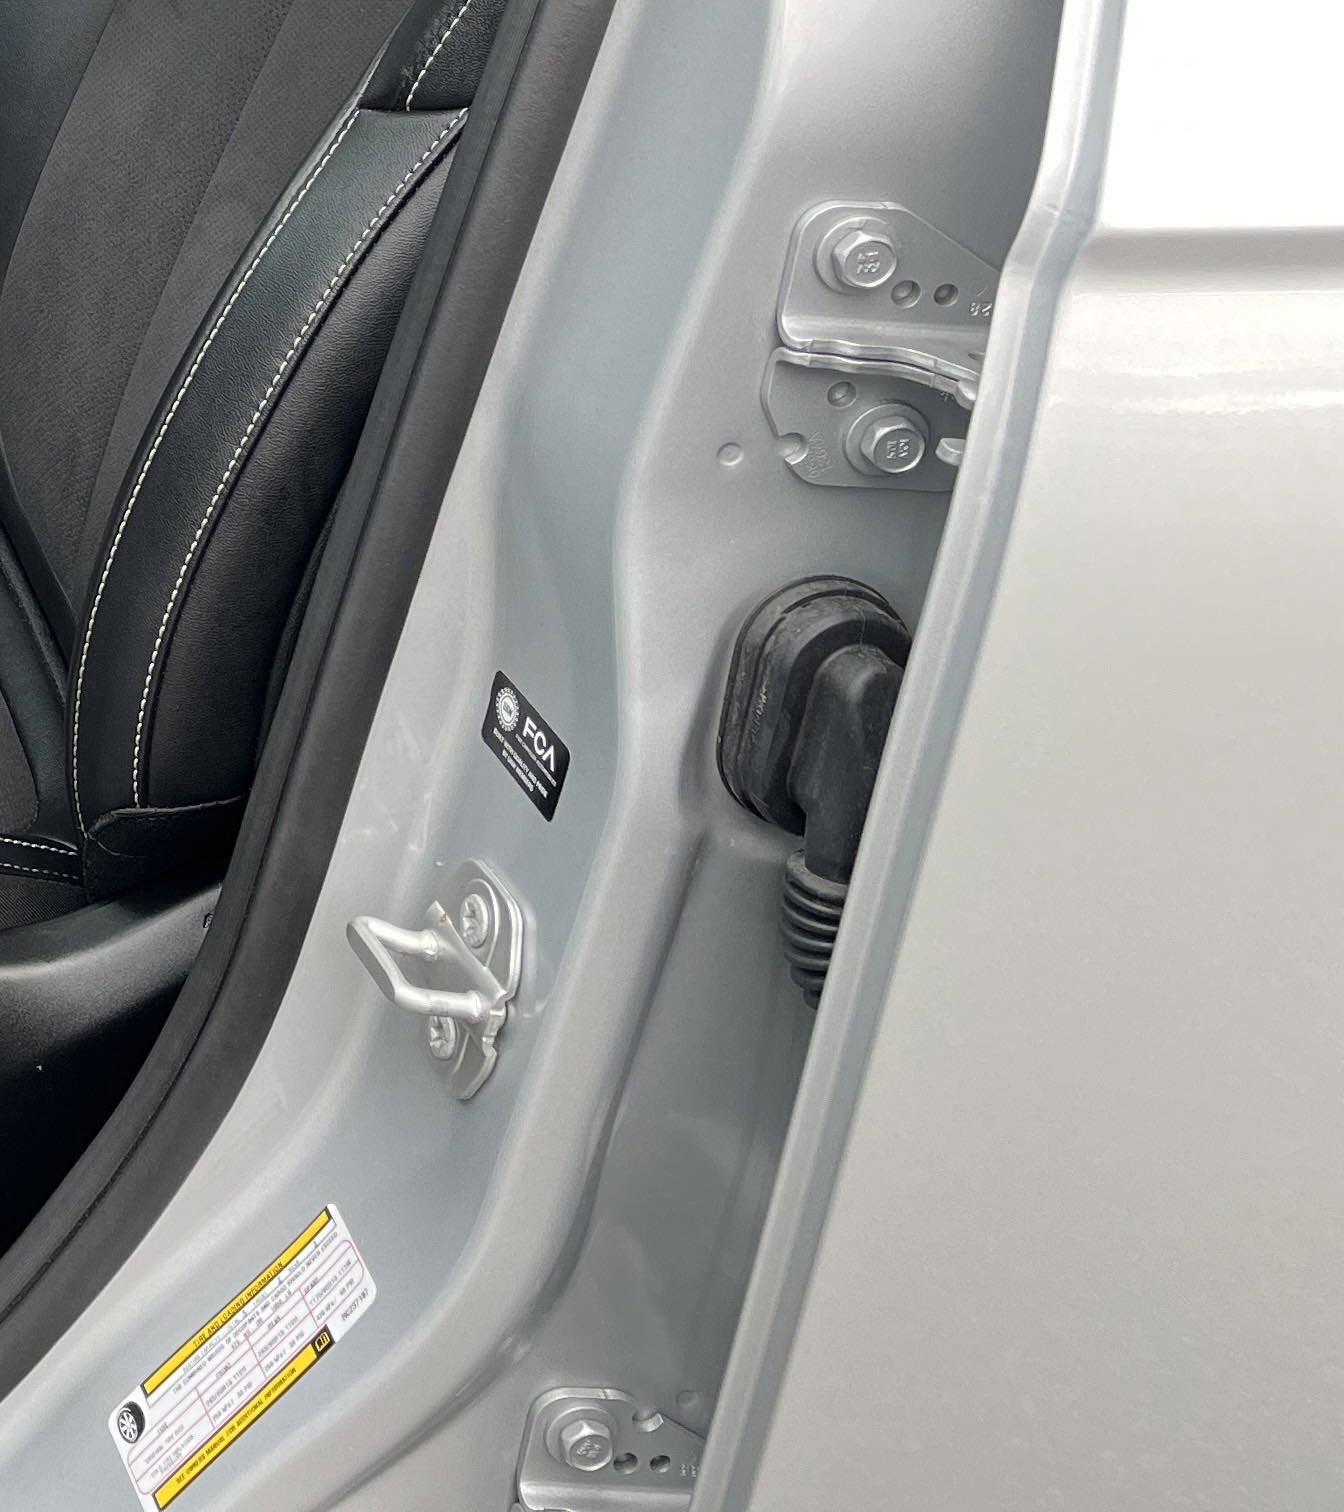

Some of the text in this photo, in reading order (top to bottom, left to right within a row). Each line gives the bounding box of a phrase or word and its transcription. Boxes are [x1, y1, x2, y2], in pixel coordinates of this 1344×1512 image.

[521, 715, 556, 773] FCA
[192, 1330, 206, 1349] TIRE
[206, 1318, 219, 1336] AND
[243, 1258, 283, 1302] INFORMATION
